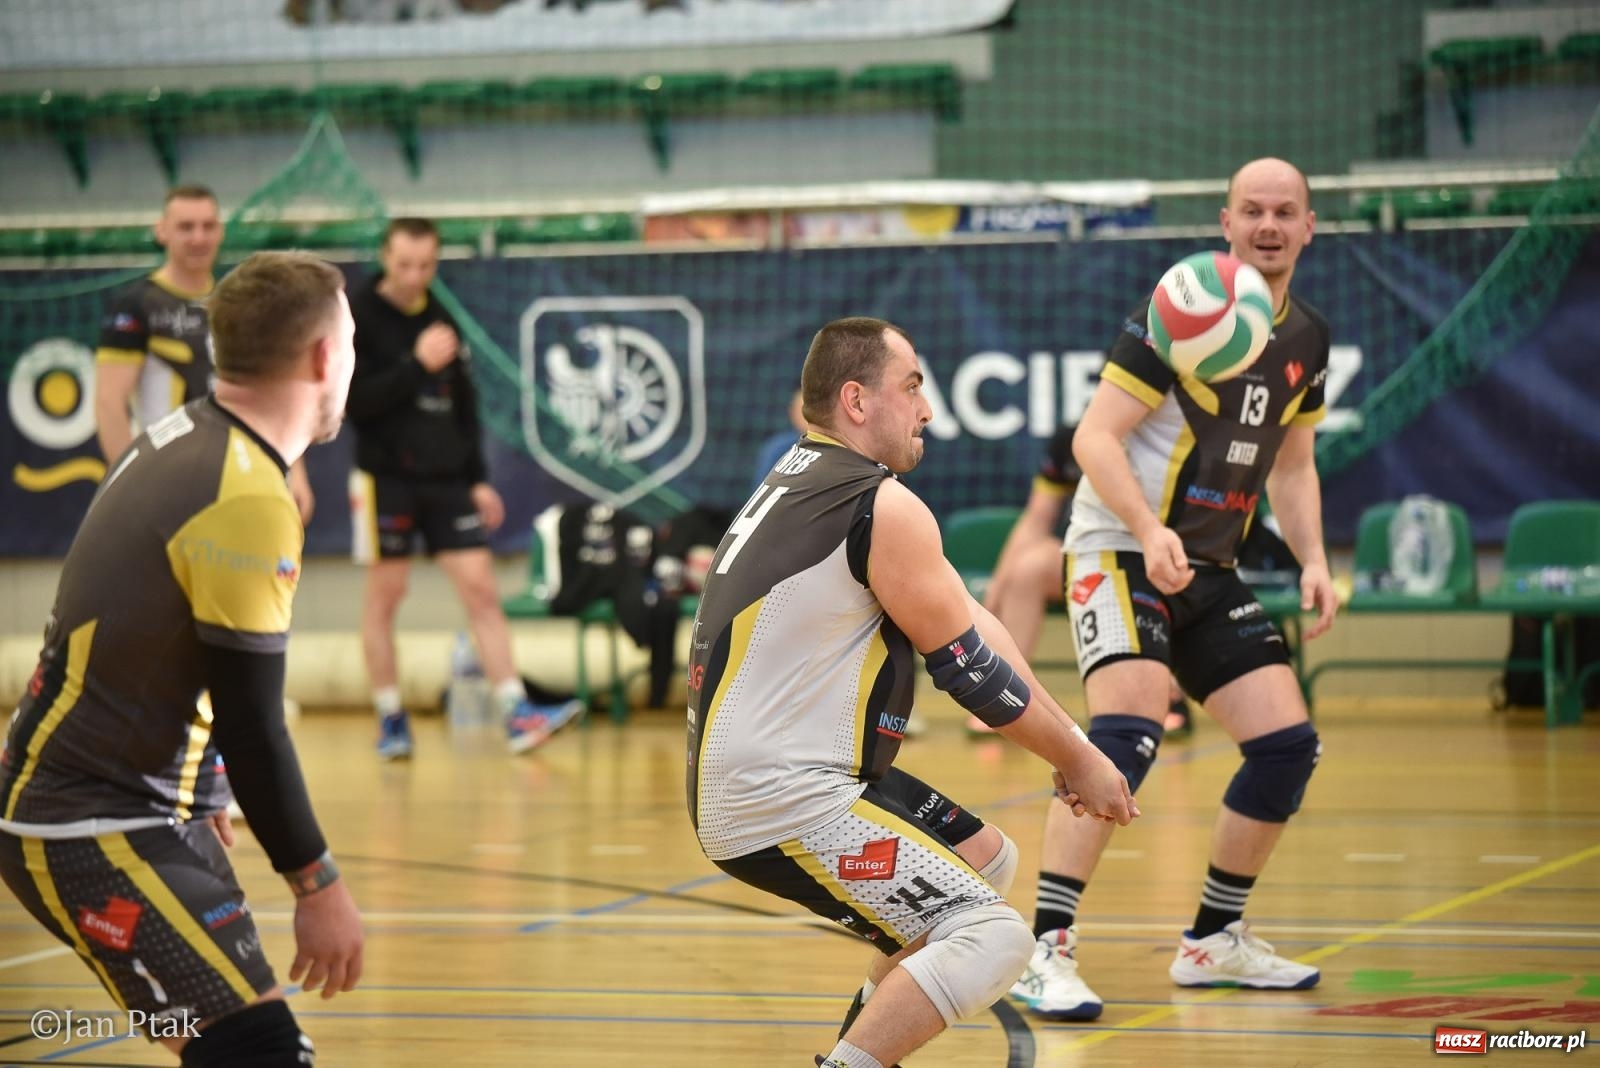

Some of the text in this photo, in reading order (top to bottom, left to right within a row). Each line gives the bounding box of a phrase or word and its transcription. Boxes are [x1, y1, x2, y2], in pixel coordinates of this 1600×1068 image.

[1239, 384, 1270, 427] 13
[1226, 439, 1259, 466] ENTER
[1075, 609, 1099, 652] 13
[845, 859, 887, 871] Enter
[85, 913, 126, 938] Enter
